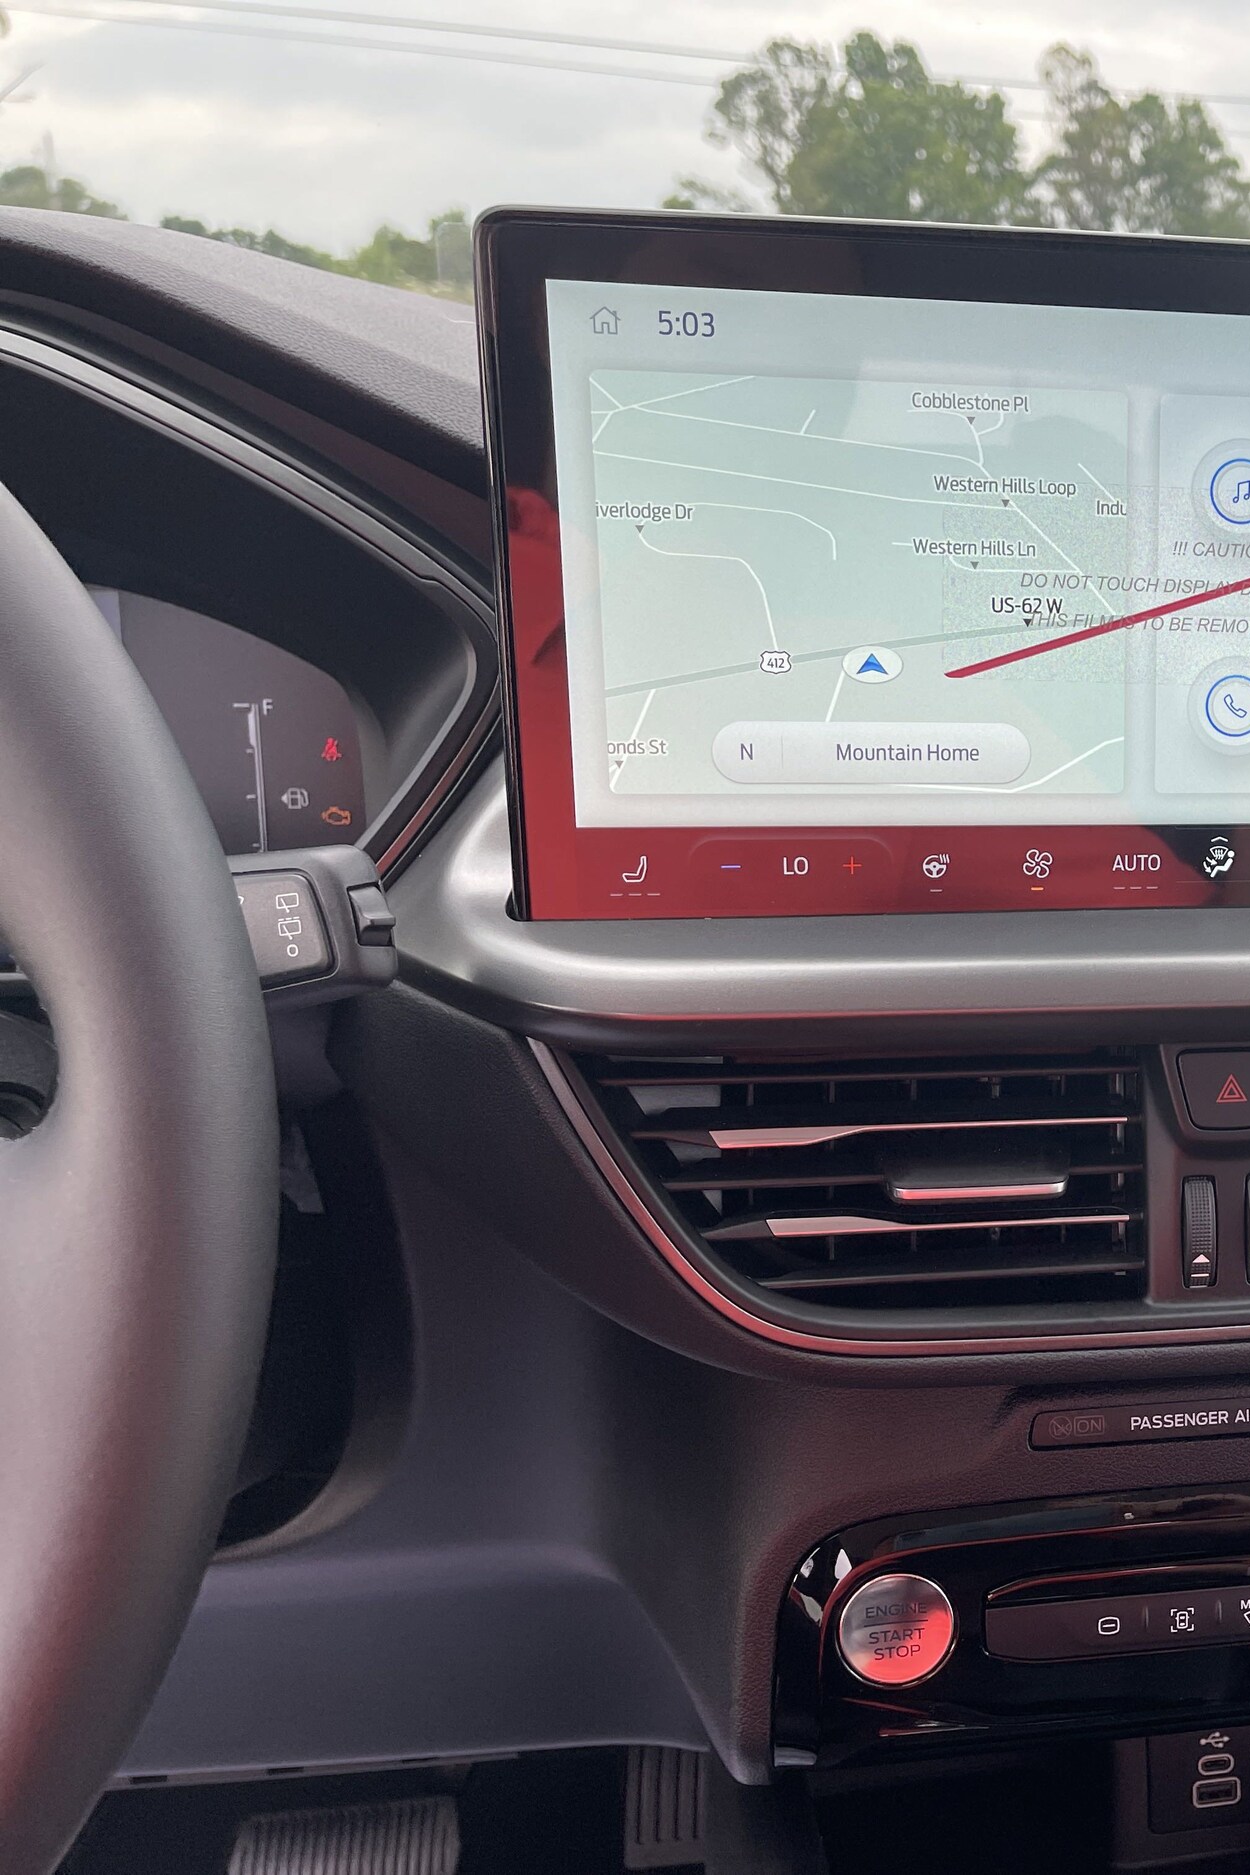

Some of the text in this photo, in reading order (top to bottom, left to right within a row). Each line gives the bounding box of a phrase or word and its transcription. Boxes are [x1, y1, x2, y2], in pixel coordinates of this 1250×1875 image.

[657, 310, 716, 338] 5:03
[911, 392, 1029, 413] Cobblestone Pl
[933, 475, 1077, 499] Western Hills Loop
[674, 503, 694, 520] Dr
[912, 537, 1036, 558] Western Hills Ln
[1020, 572, 1046, 589] DO
[1050, 574, 1093, 592] NOT
[1098, 575, 1160, 593] TOUCH
[1164, 577, 1238, 595] DISPLAY
[990, 596, 1063, 615] US-62 W
[1169, 616, 1193, 632] BE
[767, 655, 786, 669] 412
[262, 699, 273, 715] F
[607, 738, 667, 755] onds St
[740, 743, 754, 761] N
[835, 743, 980, 762] Mountain Home
[783, 857, 809, 876] LO
[1112, 854, 1161, 872] AUTO
[1130, 1410, 1229, 1431] PASSENGER
[865, 1598, 928, 1620] ENGINE
[868, 1627, 925, 1645] START
[873, 1643, 922, 1661] STOP
